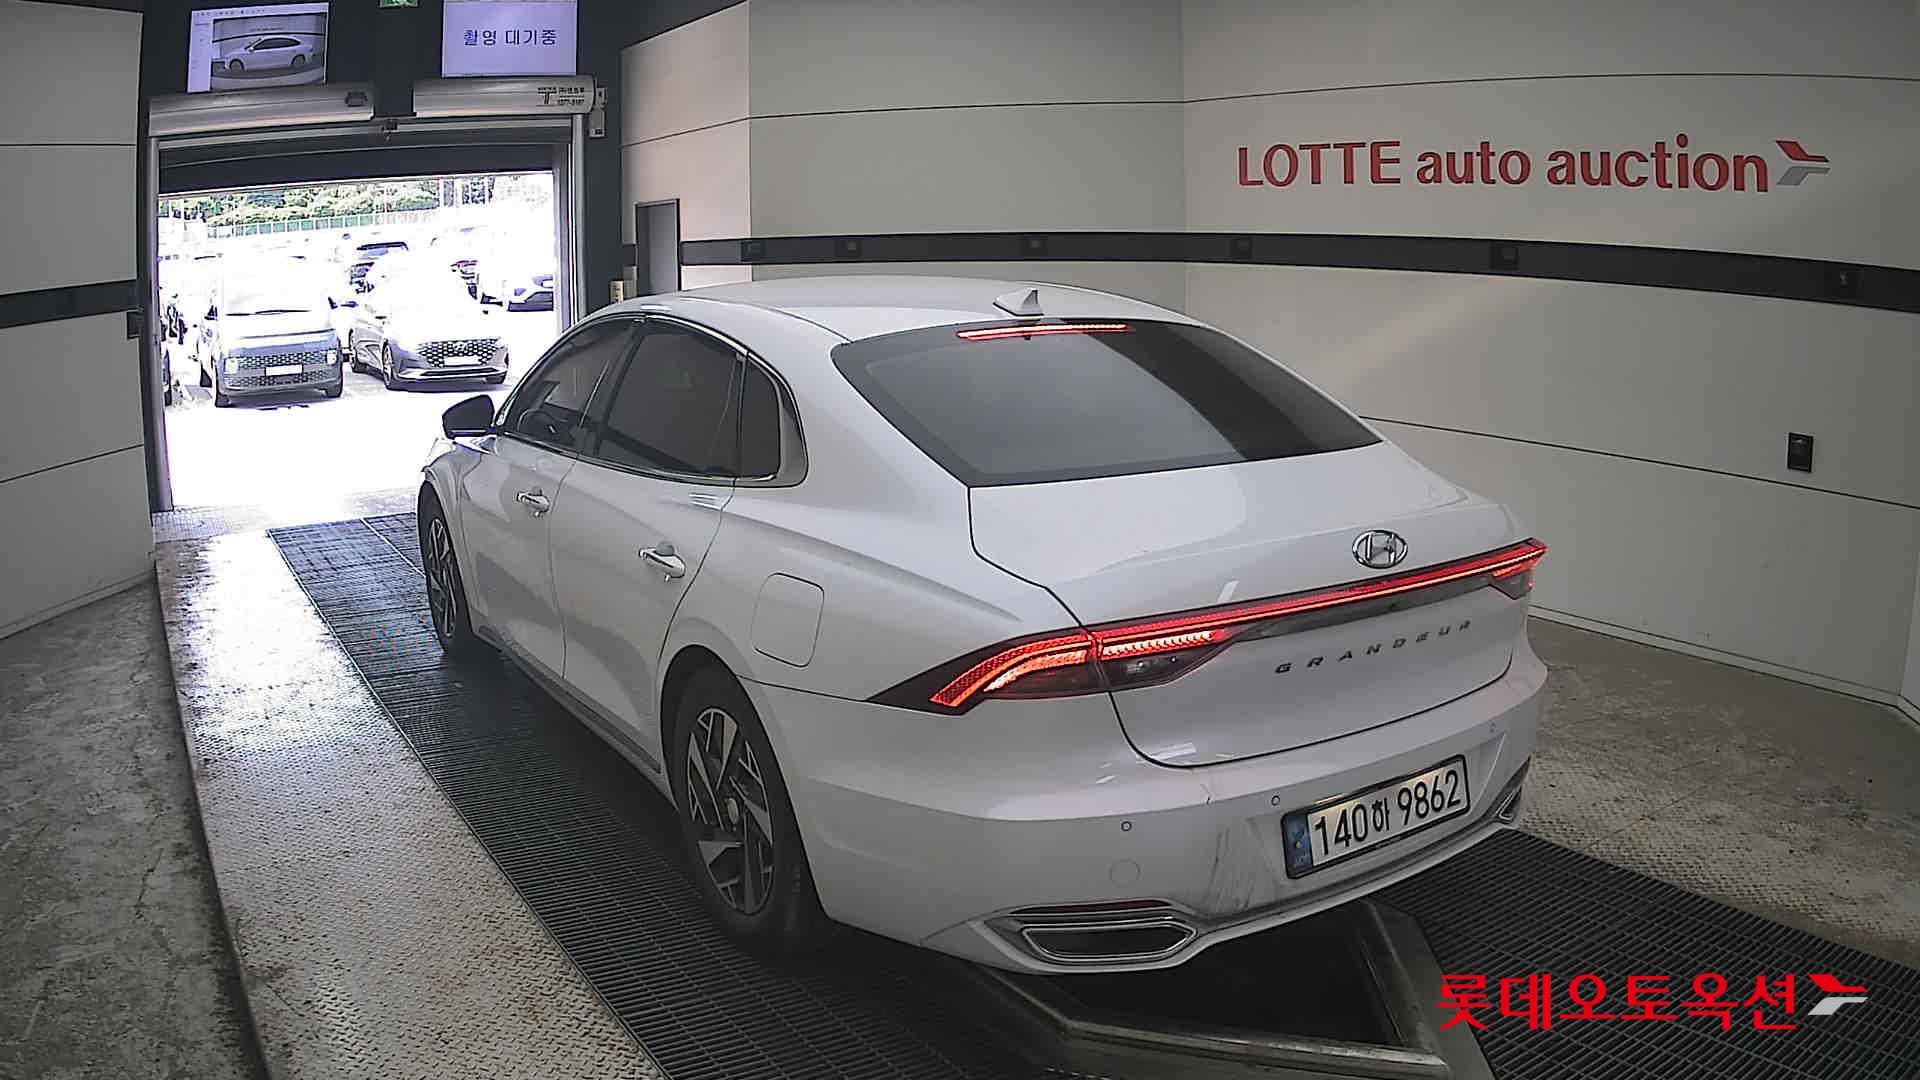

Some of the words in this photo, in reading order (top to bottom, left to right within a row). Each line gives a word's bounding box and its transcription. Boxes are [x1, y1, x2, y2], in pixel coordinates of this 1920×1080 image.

[505, 29, 557, 46] 대기중
[1238, 141, 1401, 187] LOTTE
[1416, 141, 1531, 185] auto
[1547, 133, 1768, 192] auction
[1275, 620, 1471, 674] GRANDEUR
[1315, 797, 1389, 856] 140하
[1397, 769, 1461, 826] 9862
